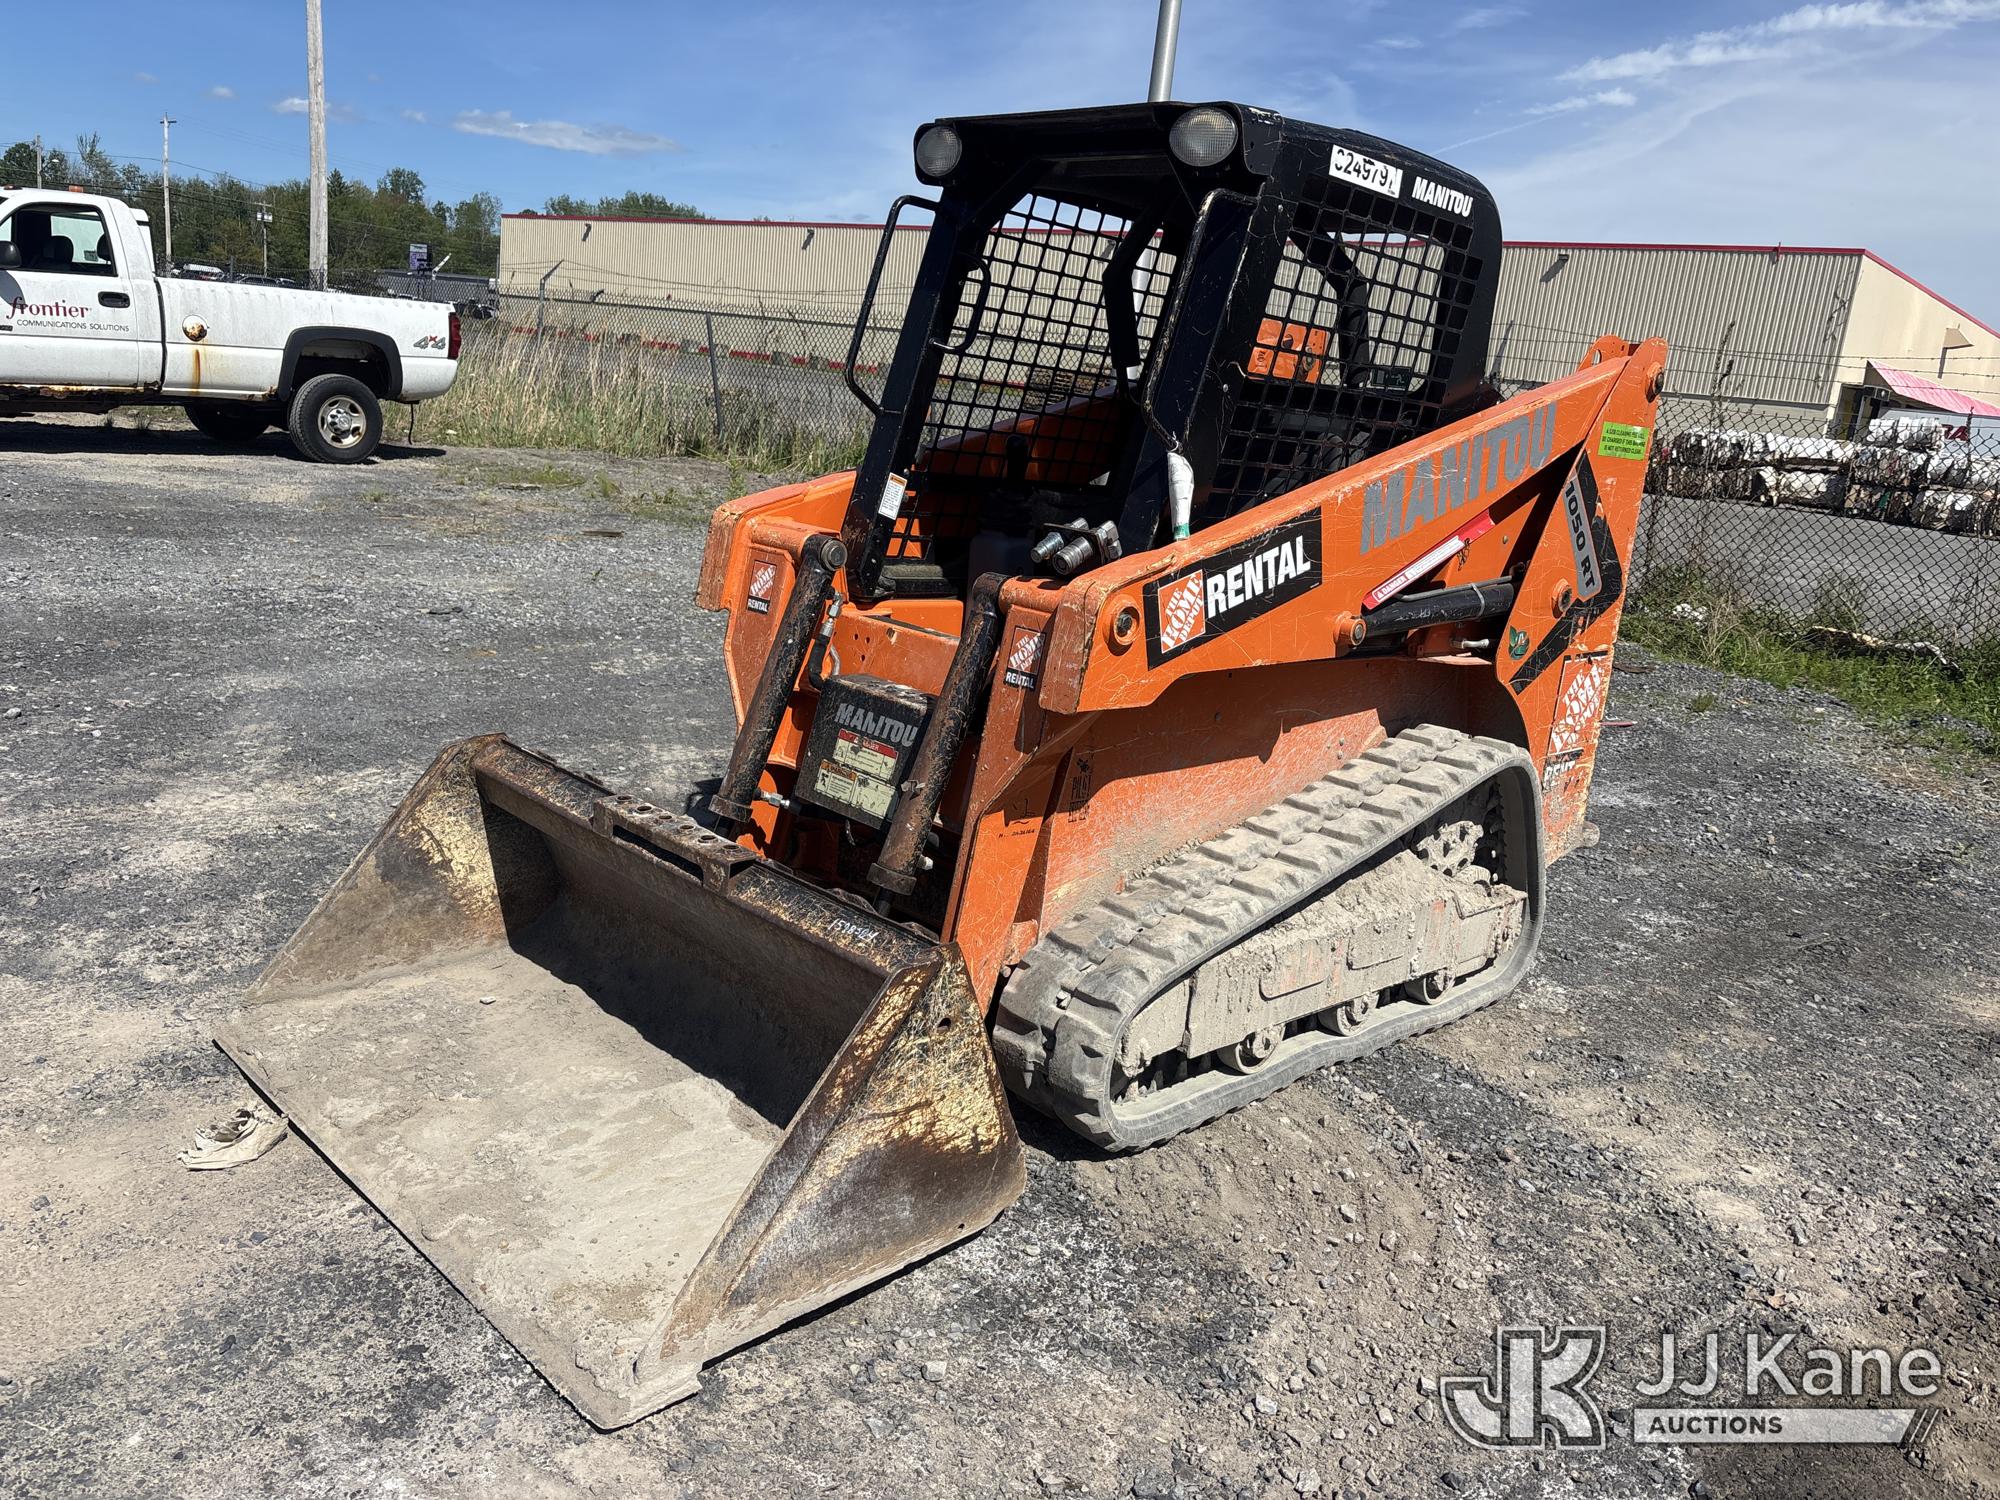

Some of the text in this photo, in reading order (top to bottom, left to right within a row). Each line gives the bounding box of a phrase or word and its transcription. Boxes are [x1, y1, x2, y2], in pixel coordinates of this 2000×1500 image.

[1412, 175, 1474, 217] MANITOU
[6, 296, 89, 319] frontier
[16, 319, 87, 330] COMMUNICATIONS
[89, 323, 130, 332] SOLUTIONS
[1359, 400, 1557, 556] MANITOU
[1565, 480, 1595, 588] 1050 RT
[750, 565, 776, 595] HOME
[1206, 535, 1311, 619] RENTAL
[748, 598, 768, 612] RENTAL
[1161, 574, 1203, 648] HOME
[1165, 587, 1183, 617] THE
[1179, 594, 1203, 641] DEPOT
[1010, 635, 1044, 668] HOME
[1016, 634, 1030, 649] THE
[1005, 671, 1034, 689] RENTAL
[834, 703, 919, 747] MANITOU
